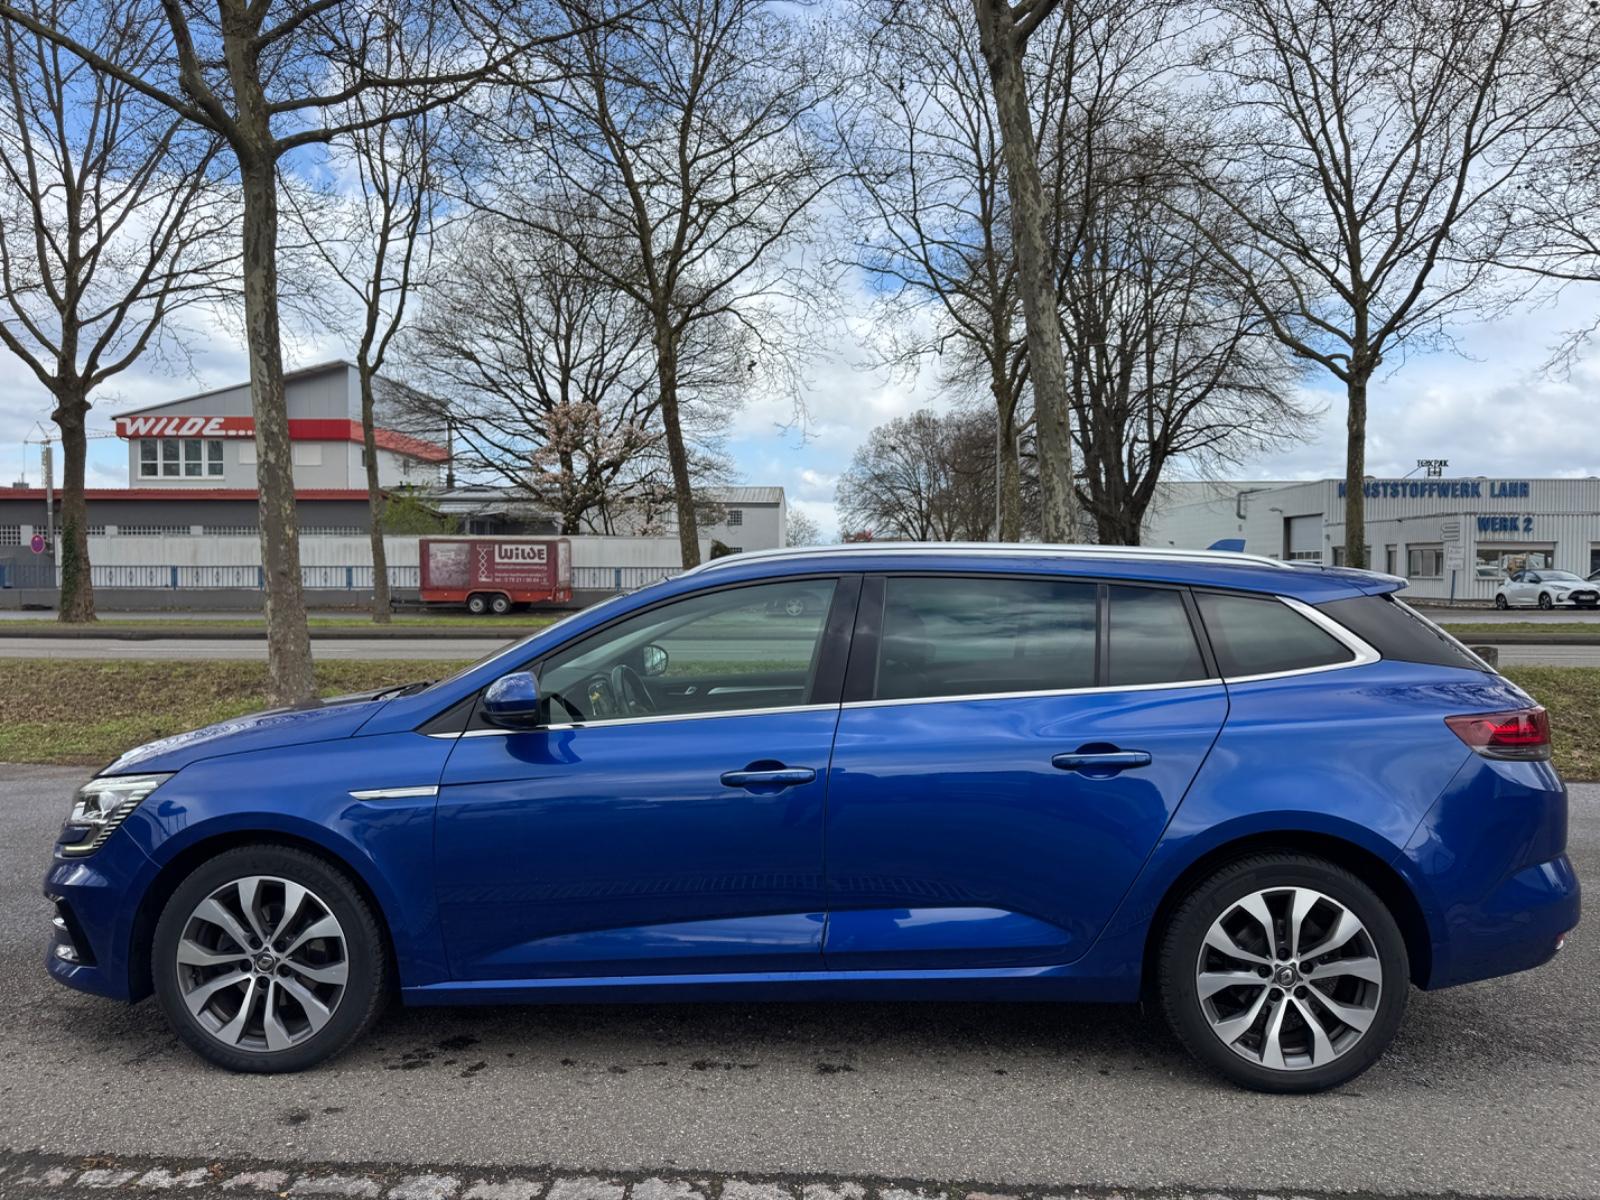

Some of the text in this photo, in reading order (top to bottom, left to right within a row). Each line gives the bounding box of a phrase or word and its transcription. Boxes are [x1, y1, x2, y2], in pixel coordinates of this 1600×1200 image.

[1338, 481, 1530, 498] KNSTSTOFFWERK LAHR
[1477, 516, 1534, 533] WERK 2
